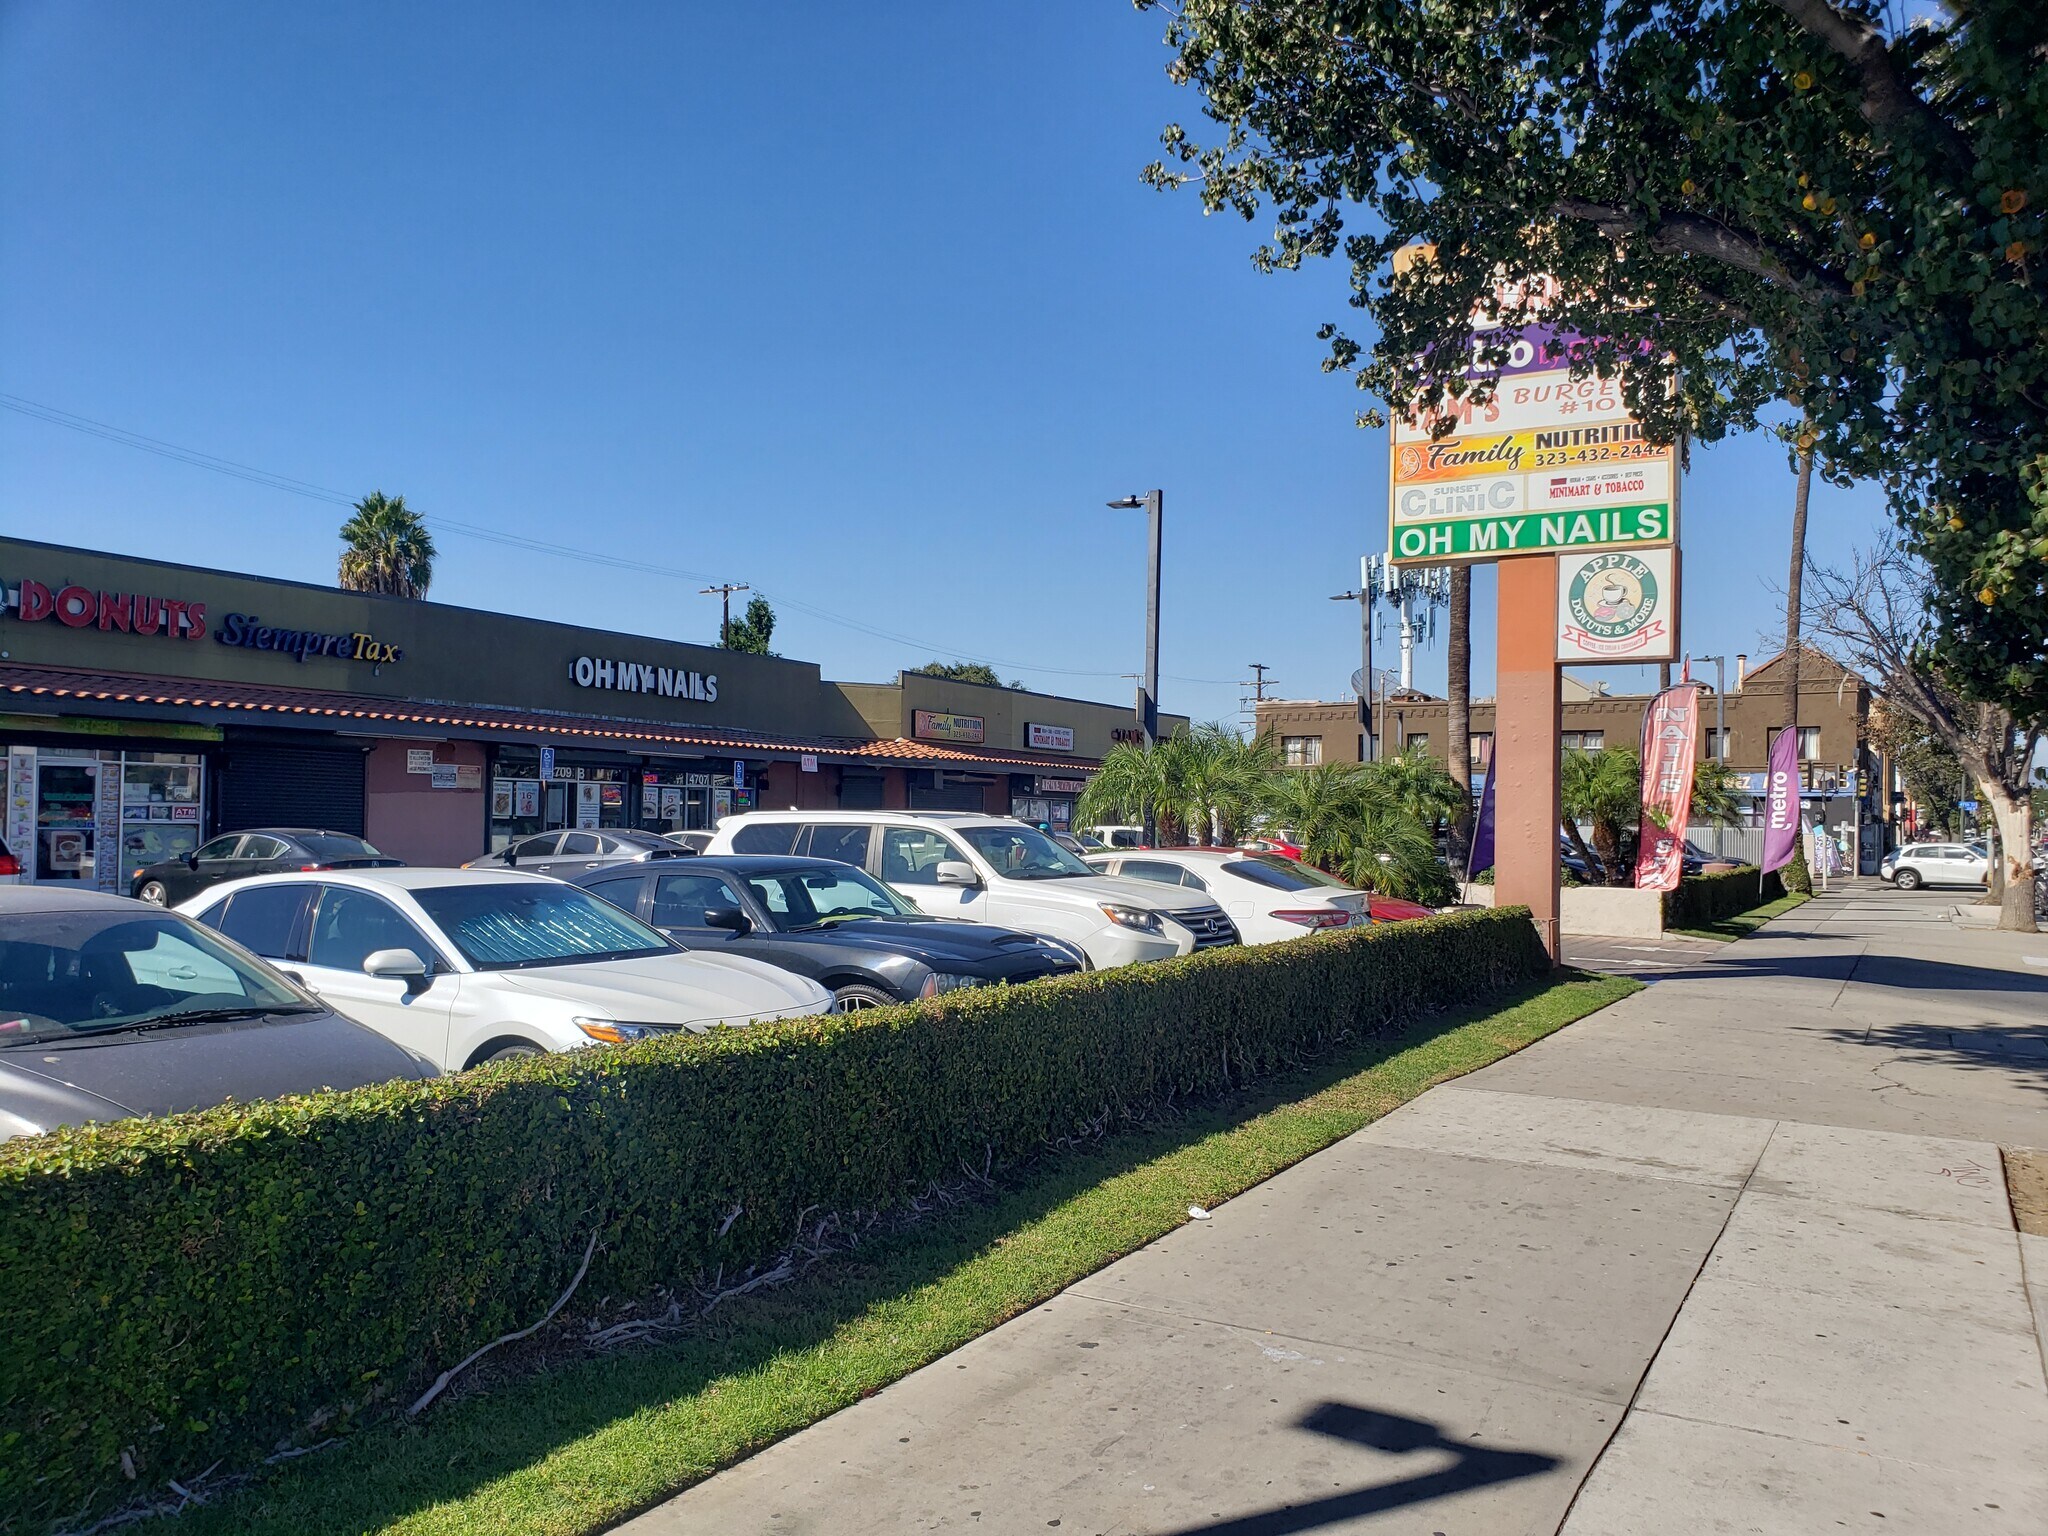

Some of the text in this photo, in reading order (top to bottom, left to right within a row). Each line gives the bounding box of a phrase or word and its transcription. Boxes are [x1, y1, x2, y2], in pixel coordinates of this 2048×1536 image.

[1513, 378, 1620, 404] BURGE
[1557, 397, 1616, 414] #10
[1427, 435, 1526, 471] Family
[1535, 443, 1666, 467] 323-432-2442
[1401, 480, 1516, 517] CLINIC
[1434, 483, 1482, 496] SUNSET
[1549, 480, 1645, 499] MINIMART & TOBACCO
[1399, 509, 1663, 556] OH MY NAILS
[1580, 555, 1649, 583] APPLE
[19, 578, 207, 640] DONUTS
[1571, 597, 1655, 635] DONUTS & MORE
[575, 656, 719, 703] OH MY NAILS
[927, 715, 982, 735] Family NUTRITION
[1656, 707, 1688, 794] NAILS
[553, 766, 572, 778] 709
[803, 760, 817, 768] ATM
[689, 774, 708, 785] 4707
[175, 808, 196, 816] ATM
[1771, 771, 1788, 829] metro
